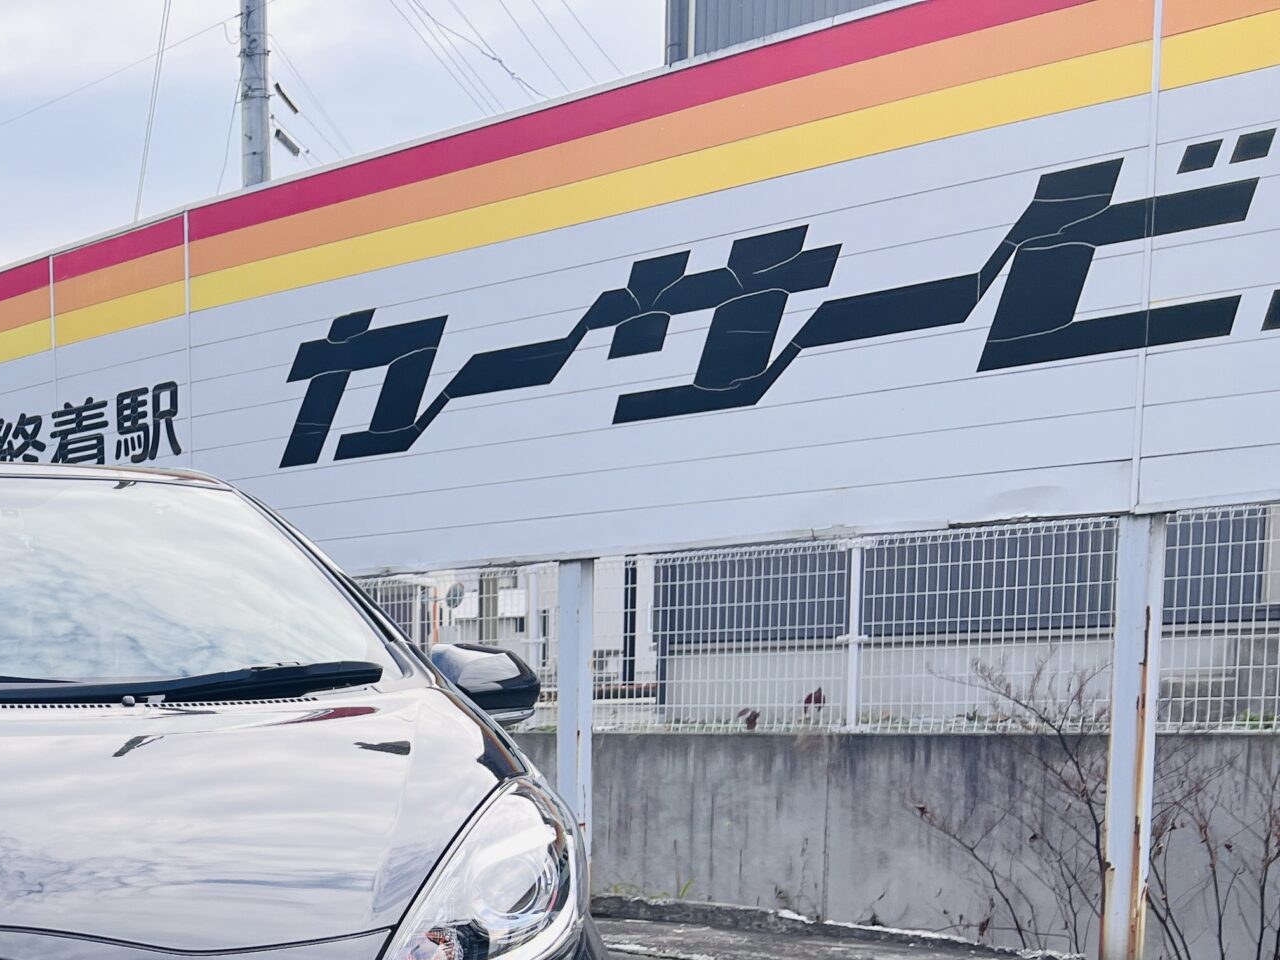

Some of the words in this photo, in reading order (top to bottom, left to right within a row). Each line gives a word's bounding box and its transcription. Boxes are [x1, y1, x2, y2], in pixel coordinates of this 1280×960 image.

[279, 128, 1280, 467] カーサービ
